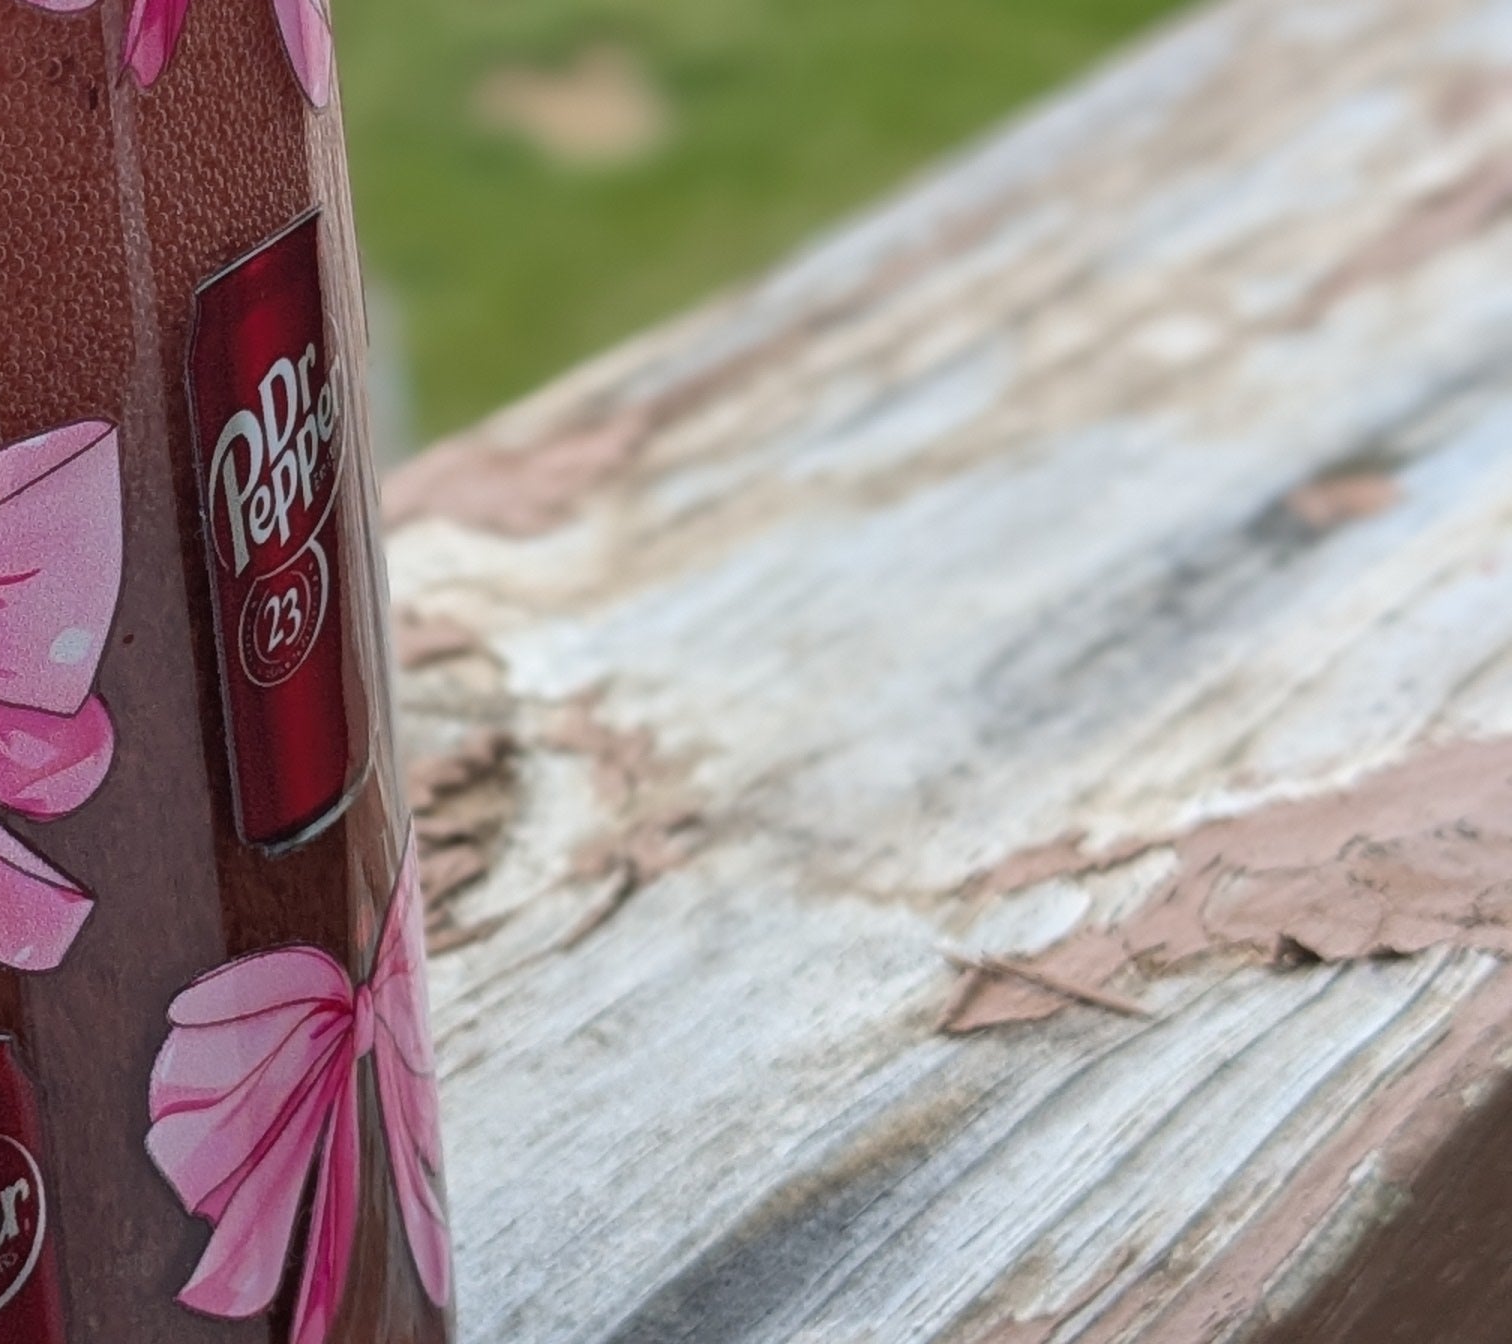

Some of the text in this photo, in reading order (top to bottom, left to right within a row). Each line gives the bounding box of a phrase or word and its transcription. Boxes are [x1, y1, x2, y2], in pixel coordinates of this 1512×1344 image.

[208, 354, 341, 578] Pepper
[258, 342, 317, 466] Dr
[264, 586, 303, 654] 23
